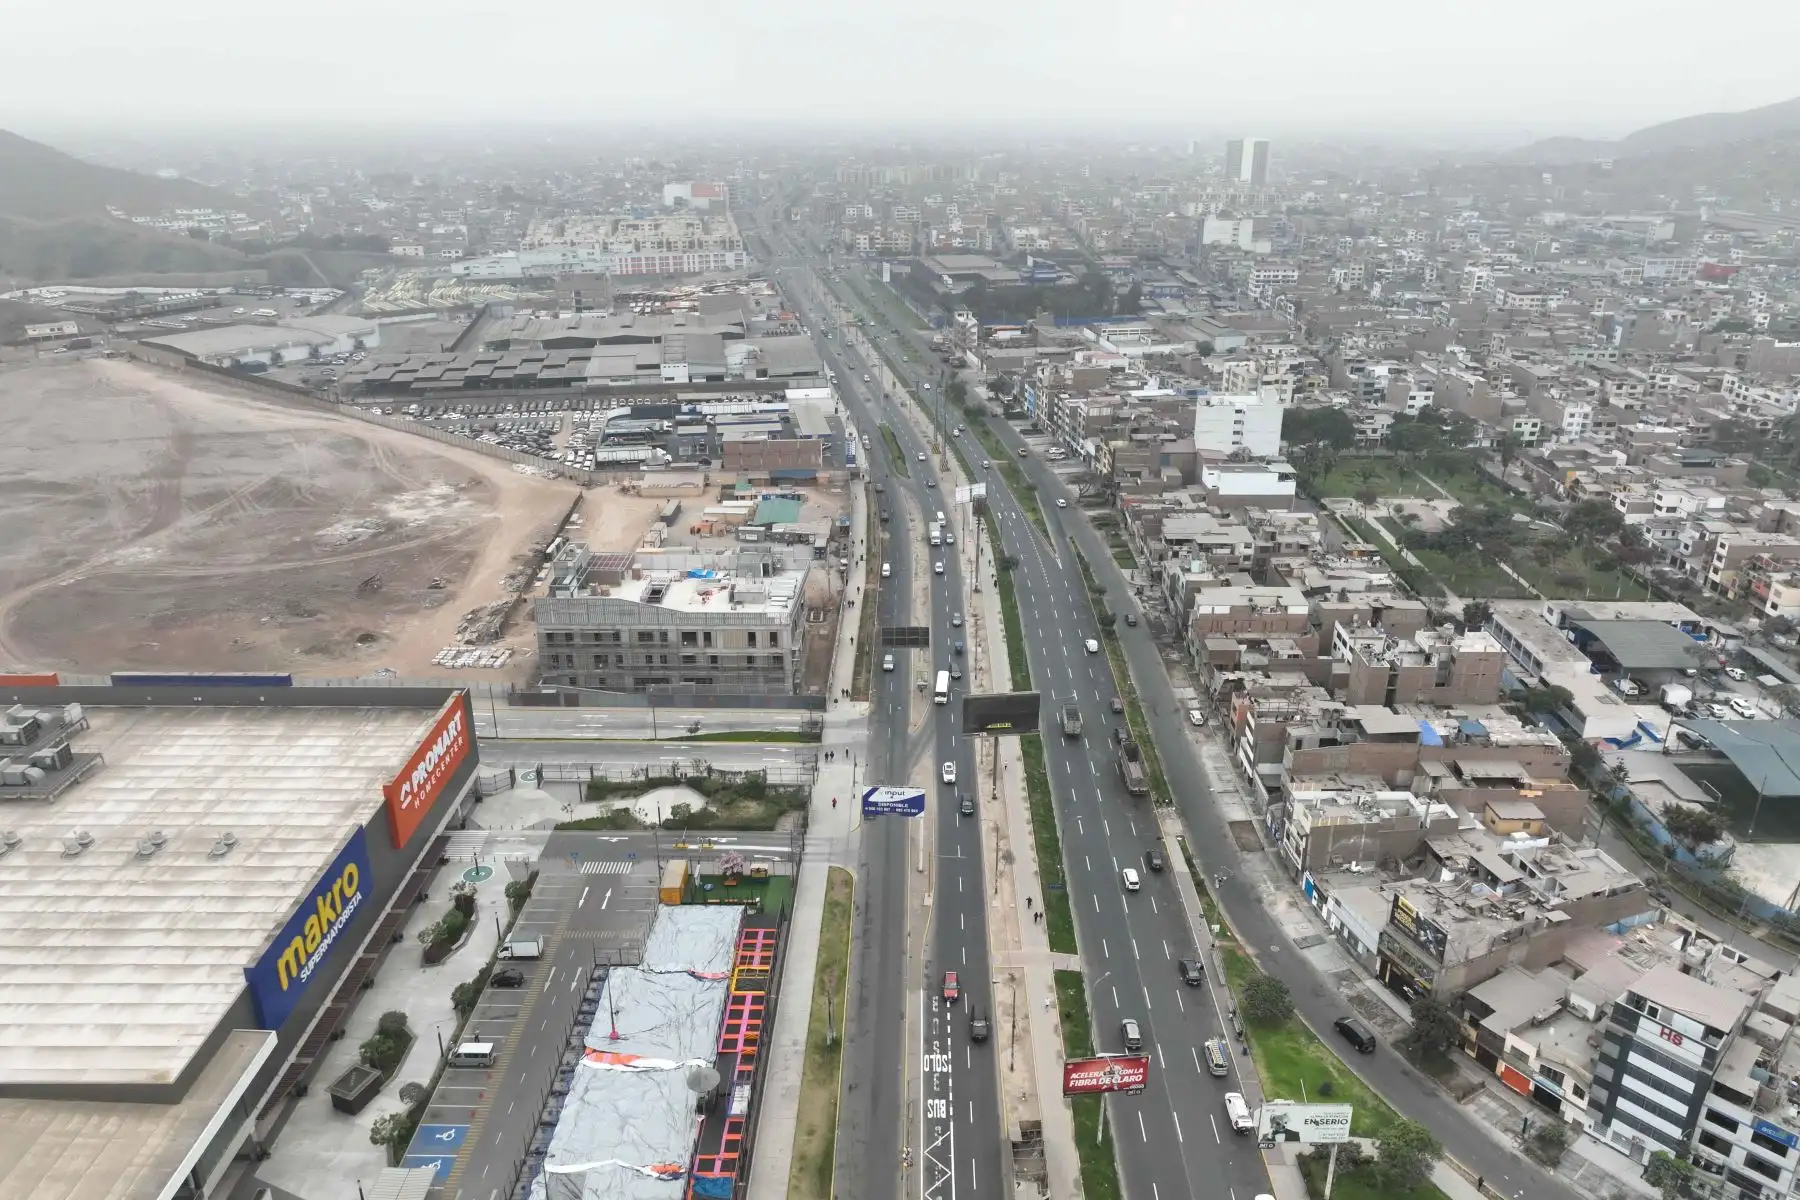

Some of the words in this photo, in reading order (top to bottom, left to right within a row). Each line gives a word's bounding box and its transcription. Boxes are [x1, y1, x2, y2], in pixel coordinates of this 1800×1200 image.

[411, 709, 462, 793] PROMART
[413, 736, 463, 809] HOMECENTER
[277, 862, 359, 992] makro
[300, 890, 363, 983] SUPERMAYORISTA
[1660, 1026, 1683, 1046] HS
[924, 1054, 948, 1072] SOLO
[1069, 1079, 1097, 1087] FIBRA
[1098, 1077, 1112, 1085] DE
[1112, 1075, 1143, 1084] CLARO
[1070, 1071, 1104, 1079] ACELERA
[927, 1099, 947, 1118] BUS
